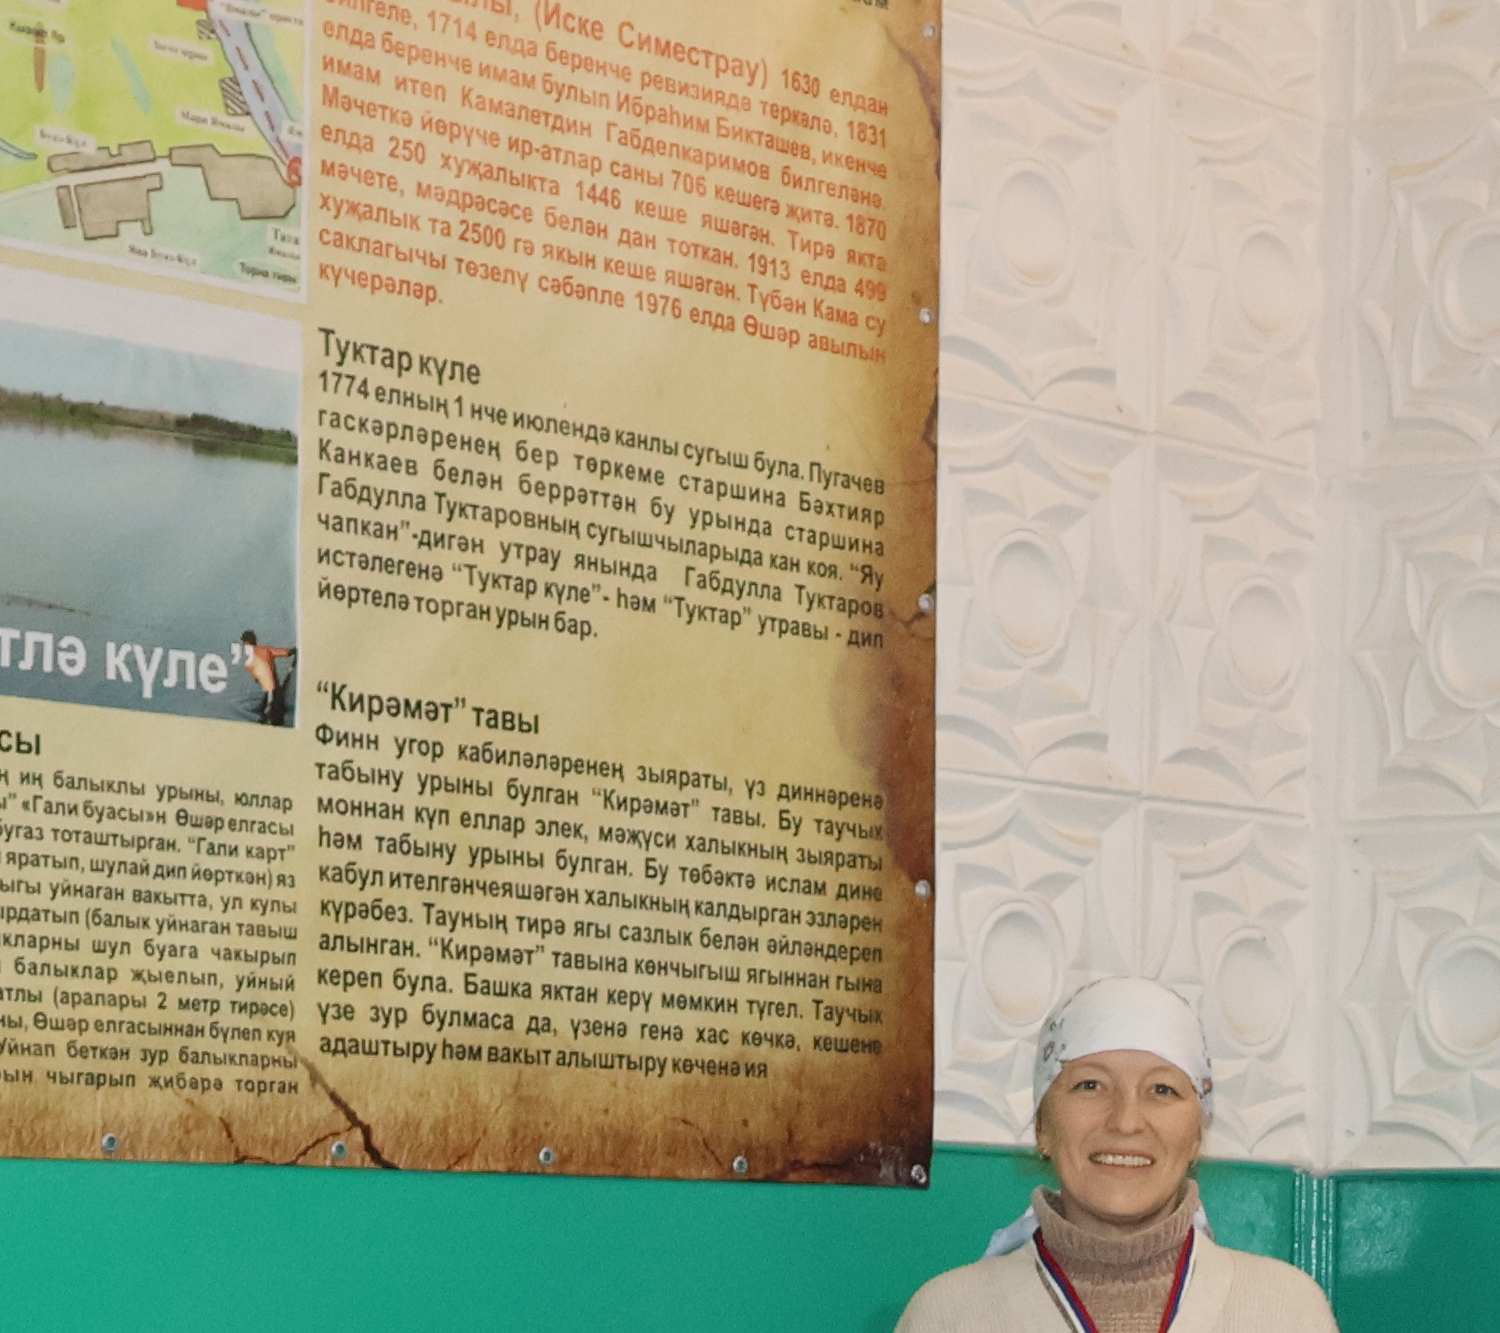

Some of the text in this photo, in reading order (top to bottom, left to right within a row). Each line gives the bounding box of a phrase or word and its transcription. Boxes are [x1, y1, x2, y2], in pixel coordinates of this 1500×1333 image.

[618, 21, 769, 90] Симестрау)
[782, 68, 820, 99] 1630
[830, 87, 889, 116] елдан
[317, 326, 481, 386] Туктар күле
[318, 368, 885, 496] 1774 елның 1 нче июлендә канлы сугыш була. Пугачев
[318, 408, 501, 462] гаскәрләренең
[515, 438, 559, 471] бер
[573, 452, 665, 486] төркеме
[678, 473, 786, 508] старшина
[317, 576, 598, 641] йөртелә торган урын бар.
[499, 540, 562, 572] утрау
[573, 552, 658, 584] янында
[684, 564, 782, 602] Габдулла
[796, 582, 885, 620] Туктаров
[105, 640, 254, 699] күле”
[471, 705, 539, 735] тавы
[19, 770, 44, 790] иң
[53, 769, 146, 796] балыклы
[155, 783, 225, 806] урыны,
[234, 791, 293, 814] юллар
[315, 722, 379, 751] Финн
[393, 736, 445, 763] угор
[457, 740, 625, 783] кабиләләренең
[636, 764, 733, 796] зыяраты,
[744, 778, 766, 800] үз
[50, 827, 181, 853] тоташтырган.
[187, 835, 239, 858] “Гали
[245, 843, 295, 865] карт”
[317, 795, 404, 821] моннан
[414, 805, 450, 830] күп
[459, 810, 526, 839] еллар
[535, 818, 589, 844] элек,
[685, 834, 789, 865] халыкның
[795, 846, 883, 872] зыяраты
[318, 824, 883, 902] һәм табыну урыны булган. Бу төбәктә ислам дине
[13, 955, 119, 985] балыклар
[235, 970, 295, 993] уйный
